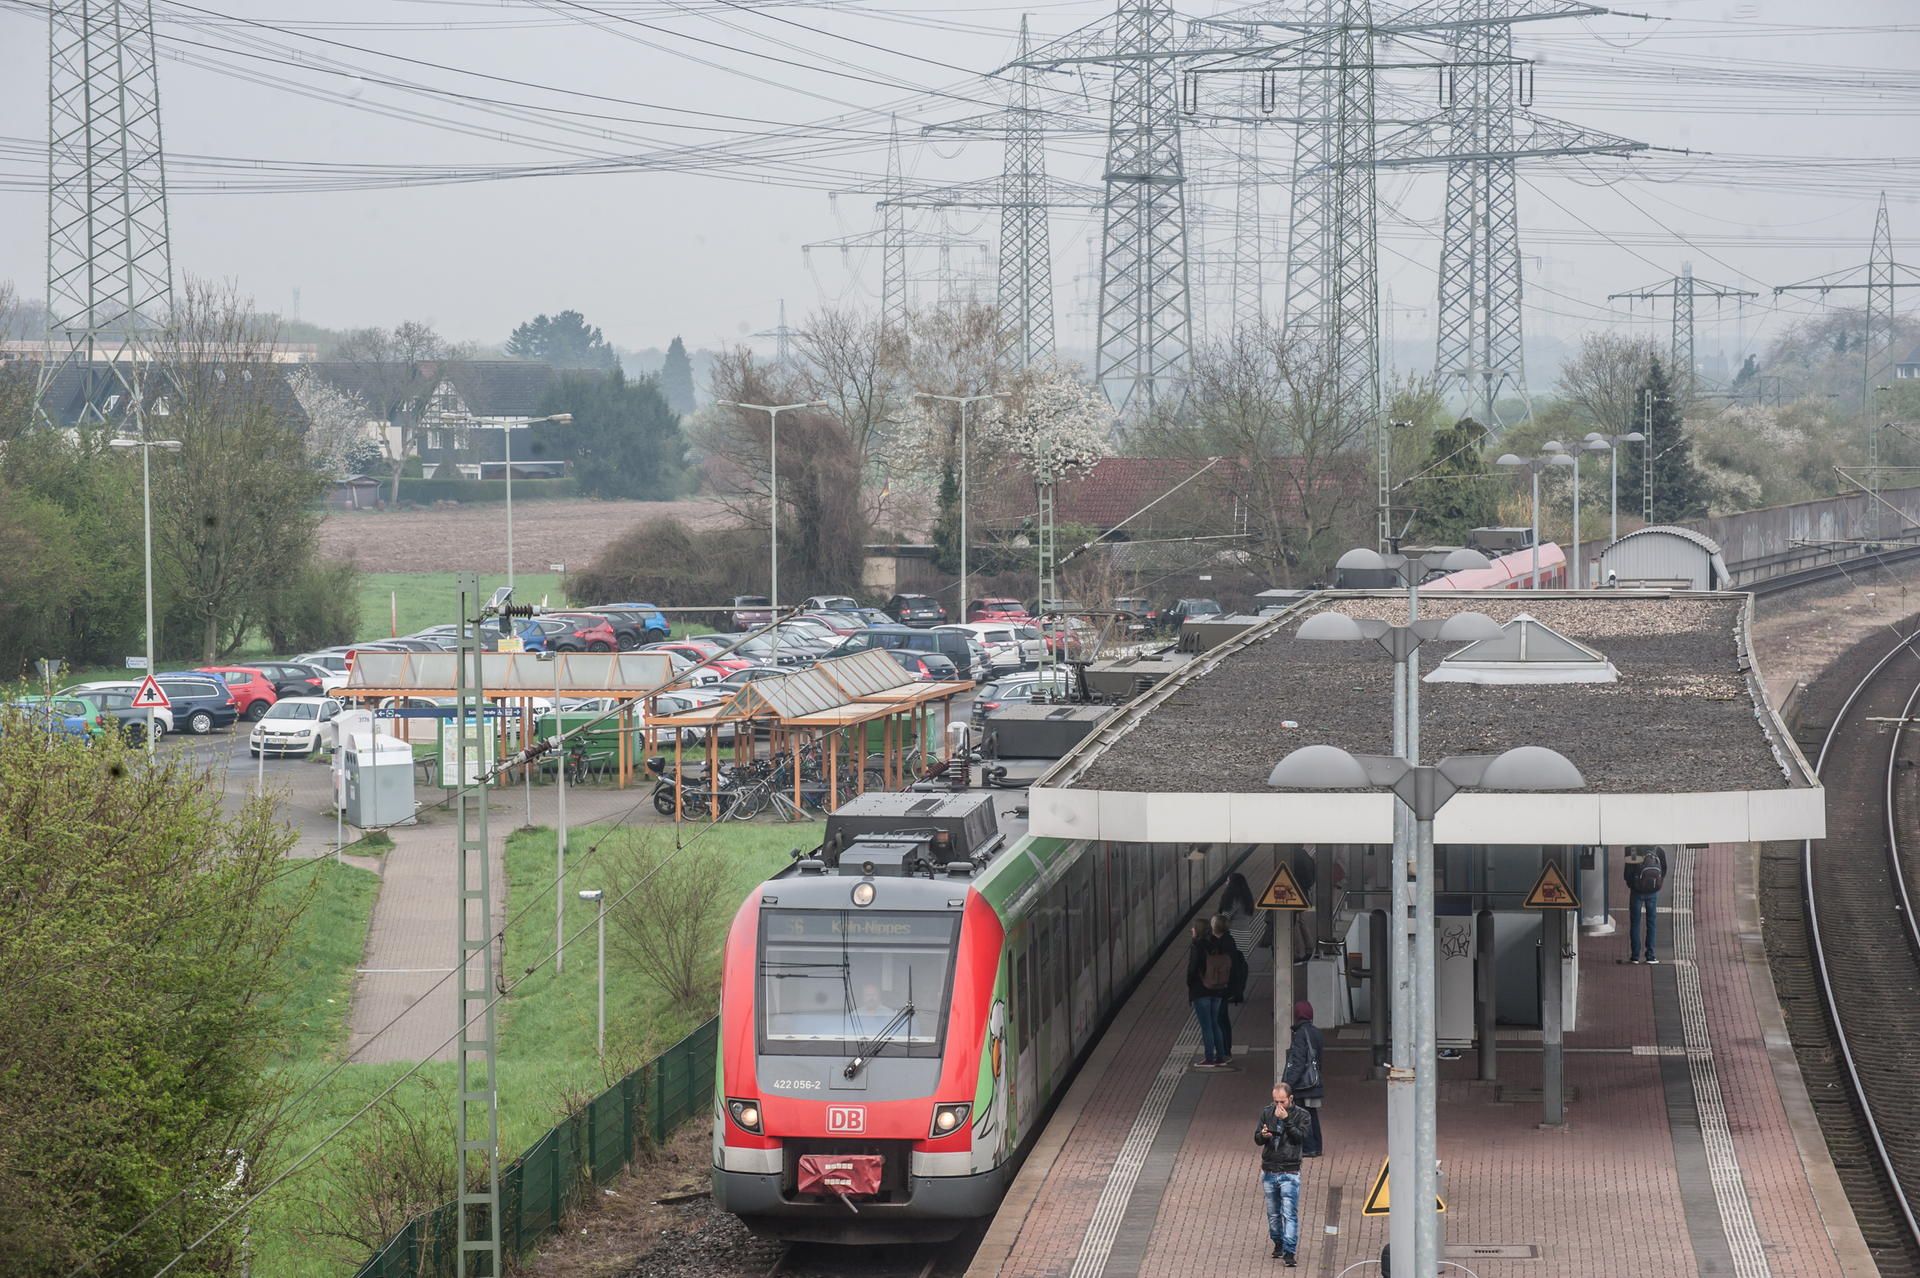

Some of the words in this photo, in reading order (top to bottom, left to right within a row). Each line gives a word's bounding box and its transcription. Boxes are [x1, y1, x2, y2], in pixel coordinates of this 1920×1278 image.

[832, 920, 911, 935] Kln-Nippes
[774, 1080, 791, 1089] 422
[793, 1081, 821, 1089] 056-2
[832, 1110, 861, 1128] DB
